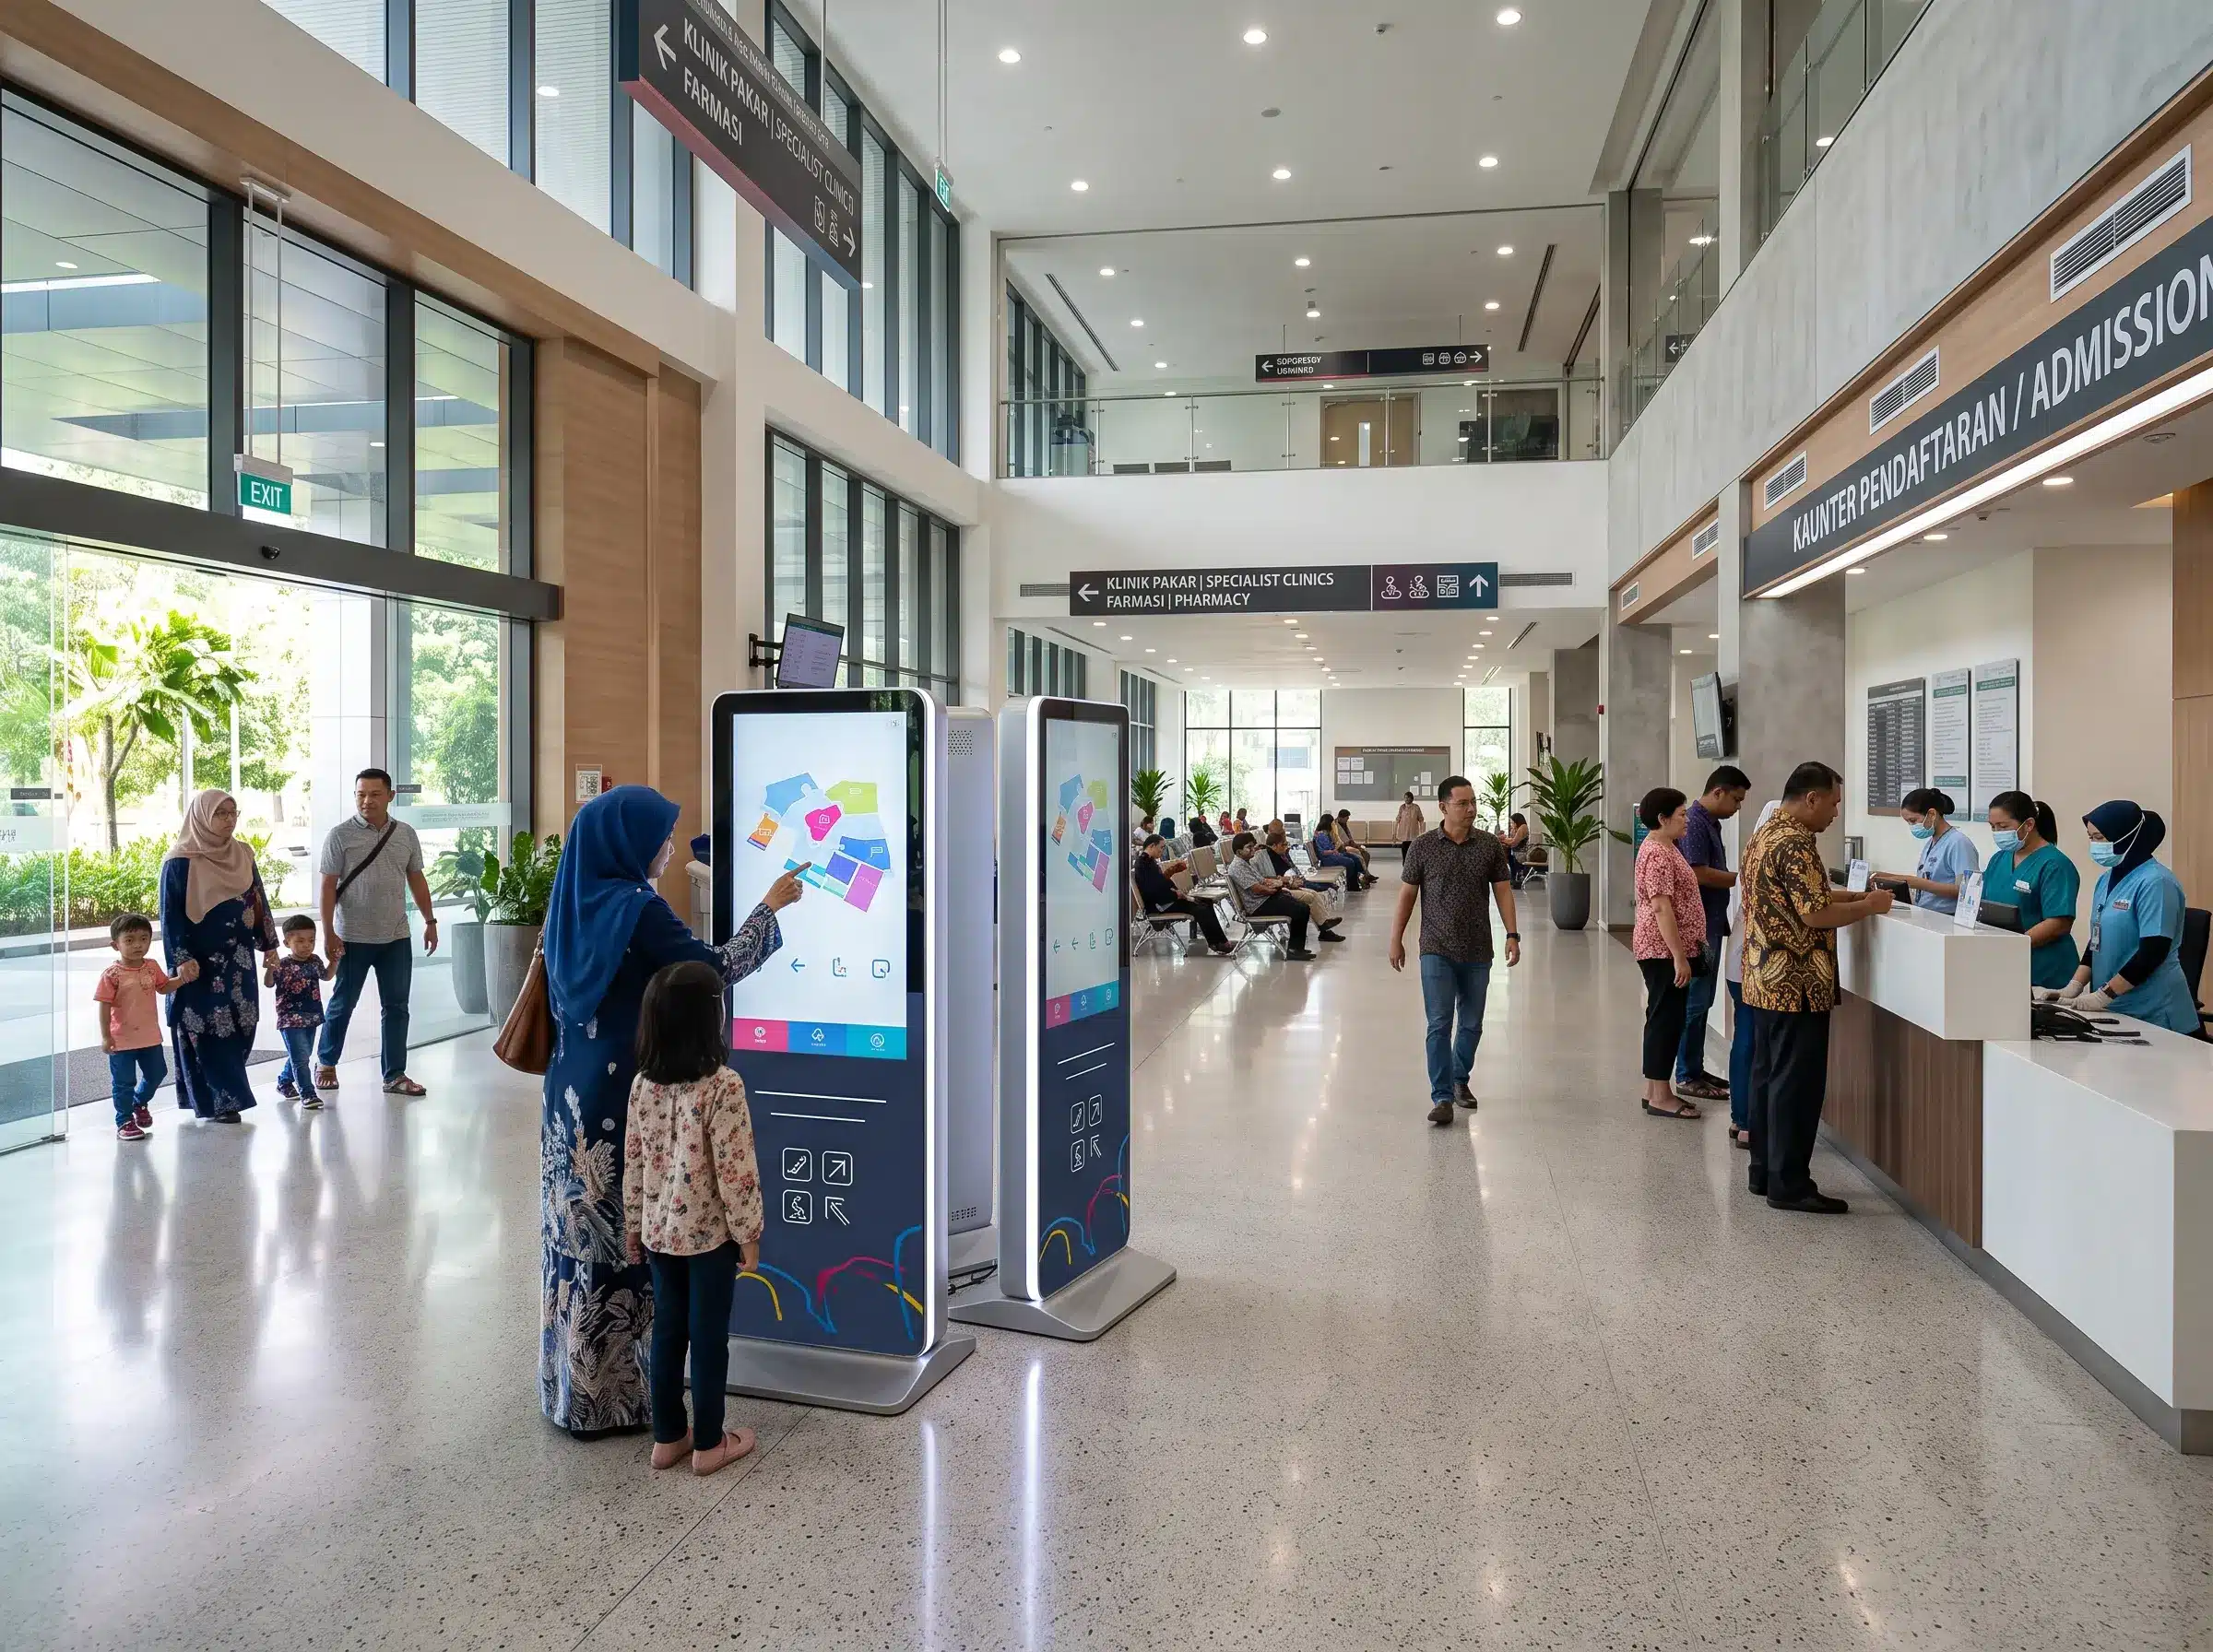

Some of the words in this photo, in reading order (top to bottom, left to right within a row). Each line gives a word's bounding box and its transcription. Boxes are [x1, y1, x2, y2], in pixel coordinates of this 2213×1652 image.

[684, 18, 728, 87] KLINIK
[730, 67, 769, 128] PAKAR
[775, 118, 823, 183] SPECIALIST
[684, 67, 742, 146] FARMASI
[251, 480, 283, 509] EXIT
[1793, 484, 1857, 553] KAUNTER
[1860, 385, 2006, 516] PENDAFTARAN
[1106, 576, 1150, 590] KLINIK
[1153, 575, 1197, 589] PAKAR
[1206, 573, 1281, 588] SPECIALIST
[1283, 572, 1334, 586] CLINICS
[1106, 595, 1165, 608] FARMASI
[1175, 593, 1251, 607] PHARMACY
